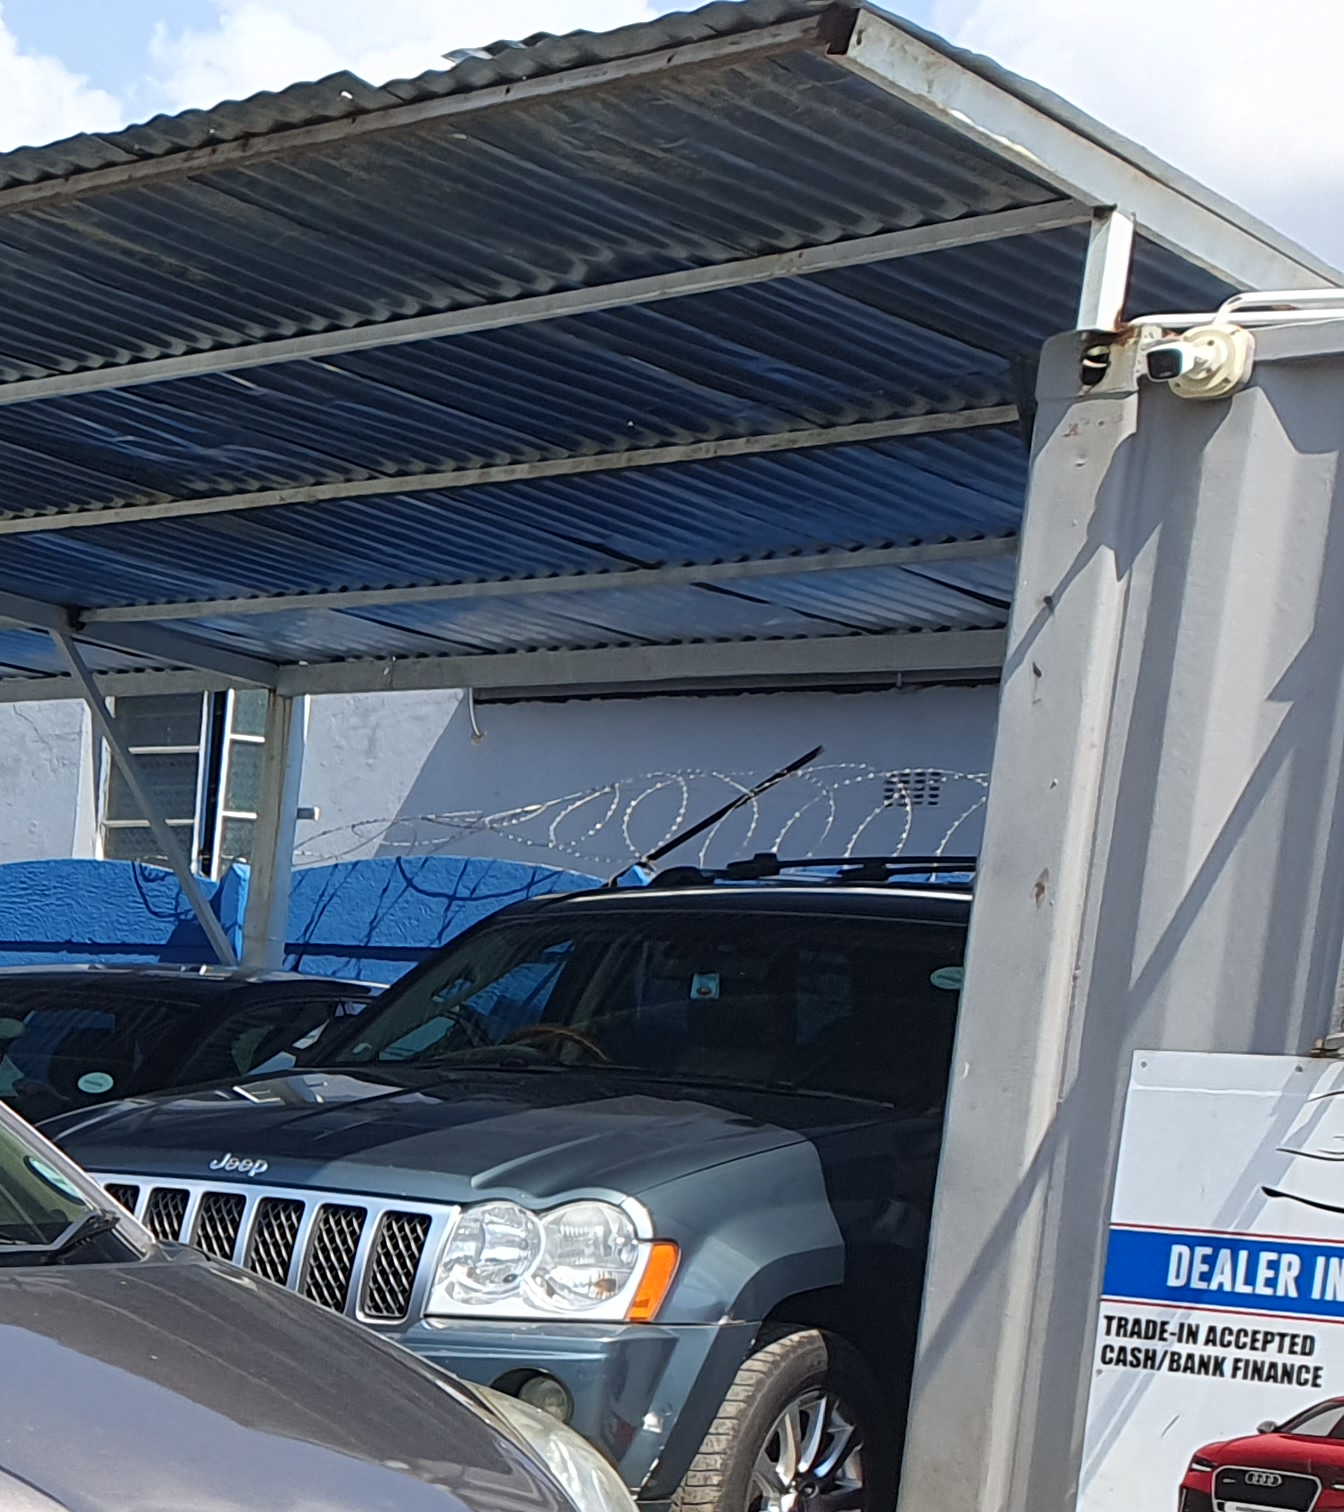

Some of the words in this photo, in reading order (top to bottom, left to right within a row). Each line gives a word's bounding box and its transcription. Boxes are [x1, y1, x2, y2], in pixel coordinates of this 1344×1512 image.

[210, 1153, 269, 1177] Jeep
[1166, 1244, 1301, 1298] DEALER
[1104, 1315, 1200, 1346] TRADE-IN
[1203, 1325, 1316, 1357] ACCEPTED
[1100, 1344, 1227, 1378] CASH/BANK
[1231, 1357, 1324, 1388] FINANCE
